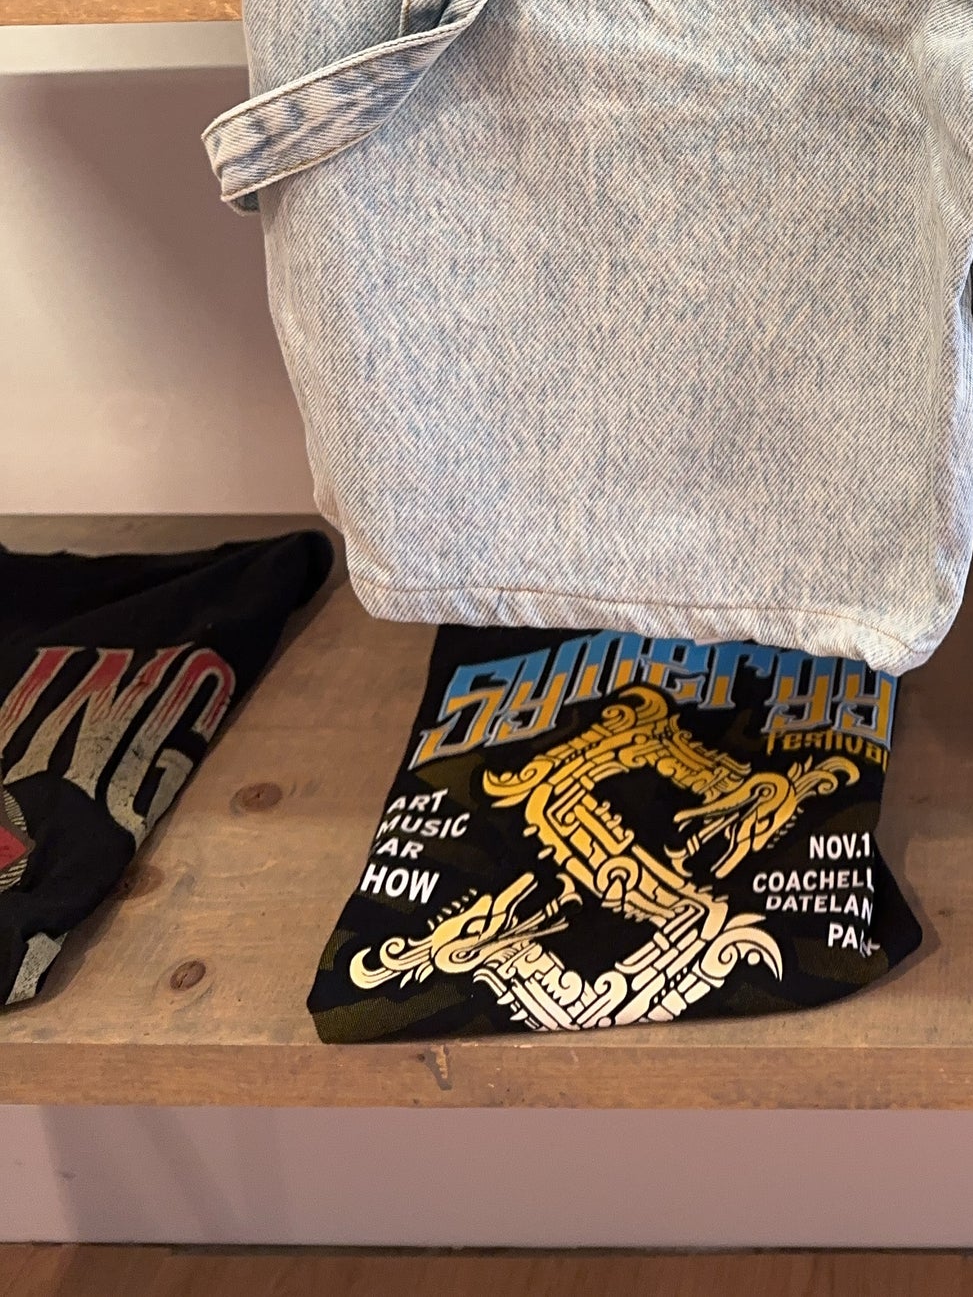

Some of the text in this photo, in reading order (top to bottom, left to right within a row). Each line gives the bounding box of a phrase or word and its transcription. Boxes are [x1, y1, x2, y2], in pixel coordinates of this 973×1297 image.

[386, 787, 449, 814] ART
[375, 812, 471, 840] MUSIC
[370, 837, 425, 860] AR
[809, 832, 874, 860] NOV.1
[752, 867, 875, 894] COACHELL
[765, 893, 873, 927] DATELAN
